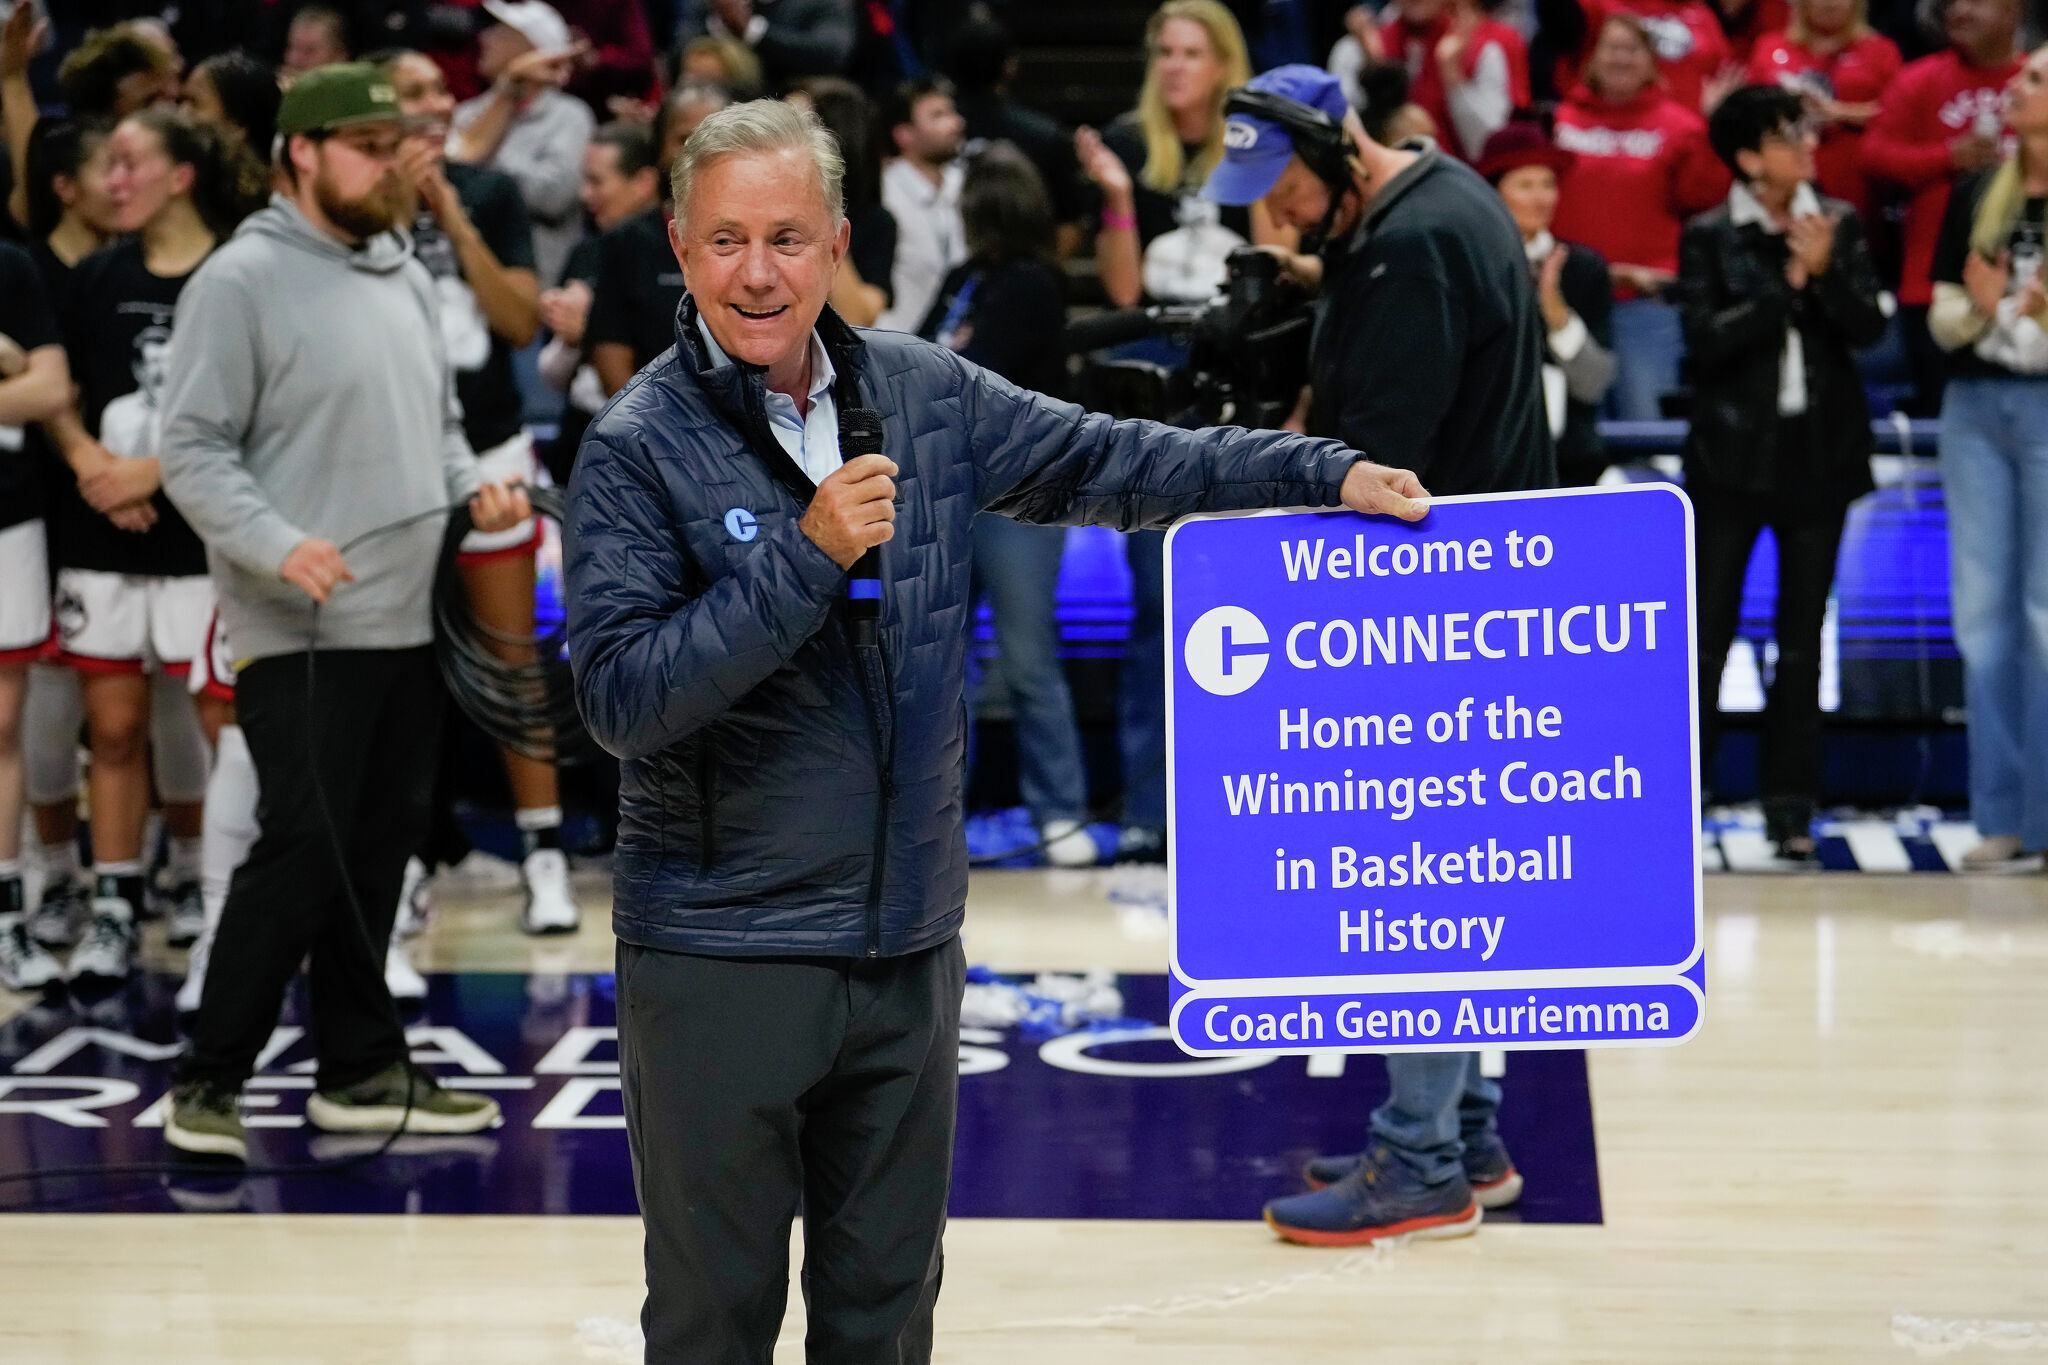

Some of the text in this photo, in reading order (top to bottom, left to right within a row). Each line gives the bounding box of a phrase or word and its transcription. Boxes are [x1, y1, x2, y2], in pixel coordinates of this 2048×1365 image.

[1281, 530, 1553, 581] Welcome to
[1286, 602, 1666, 669] CONNECTICUT
[1280, 696, 1561, 749] Home of the
[1223, 756, 1641, 820] Winningest Coach
[1276, 835, 1571, 890] in Basketball
[1340, 908, 1505, 961] History
[1205, 995, 1669, 1042] Coach Geno Auriemma
